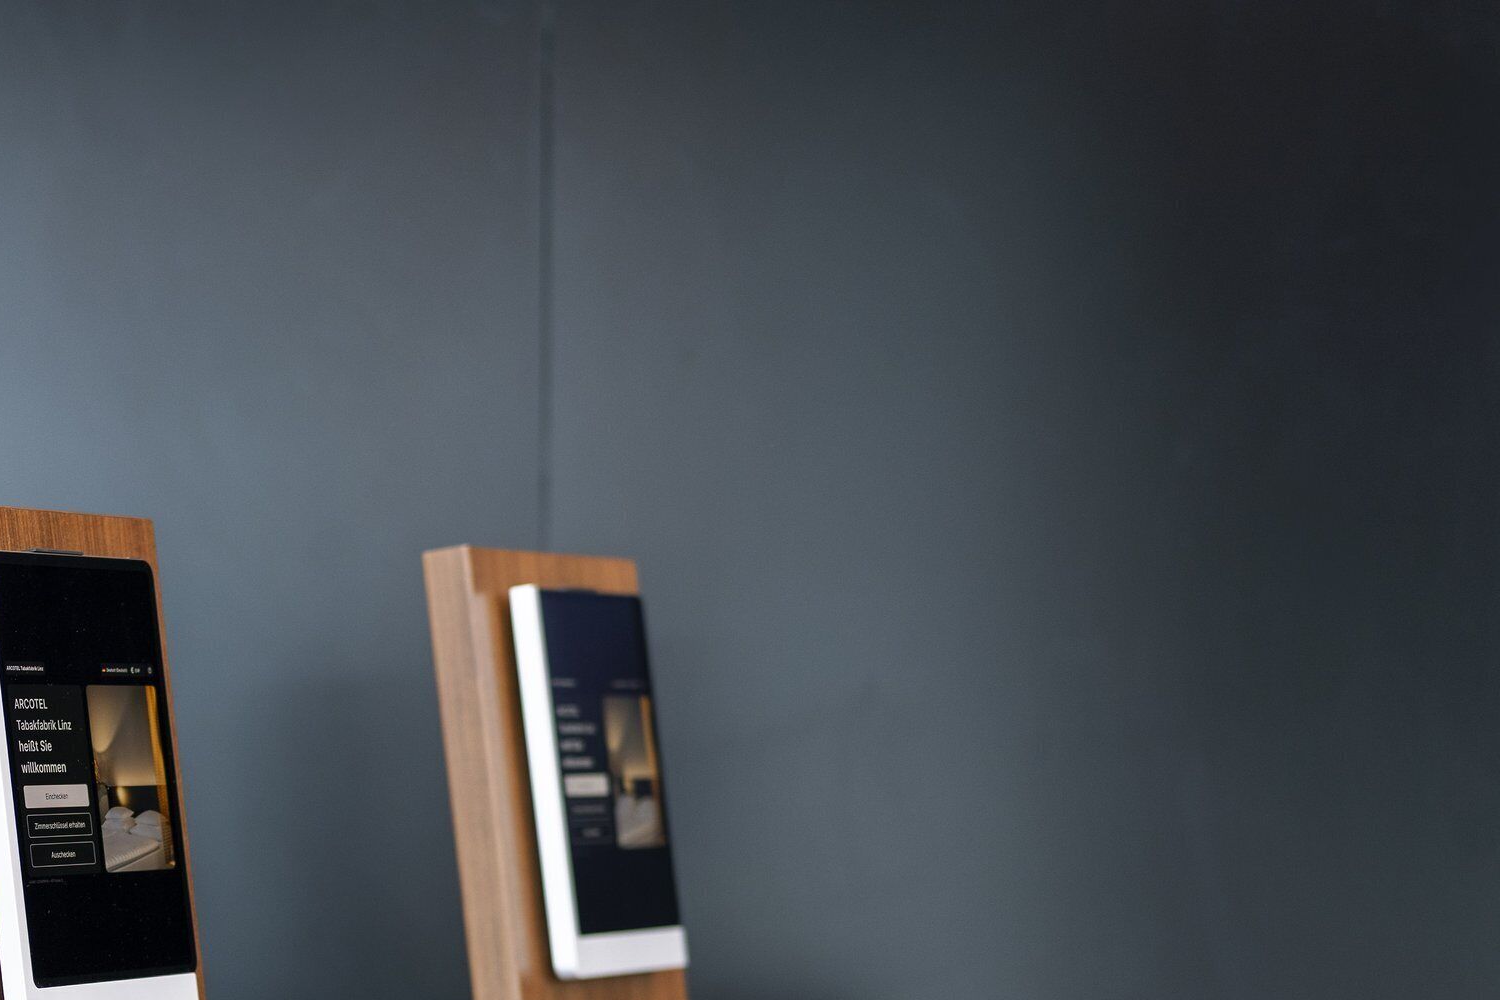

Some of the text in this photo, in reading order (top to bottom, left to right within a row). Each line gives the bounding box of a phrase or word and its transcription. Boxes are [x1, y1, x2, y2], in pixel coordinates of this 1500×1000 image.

[14, 698, 48, 710] ARCOTEL
[16, 719, 72, 731] Tabakfabrik Linz
[18, 739, 53, 752] heißt Sie
[21, 761, 67, 774] willkommen
[45, 792, 68, 801] Einchecken
[51, 851, 76, 859] Auschecken
